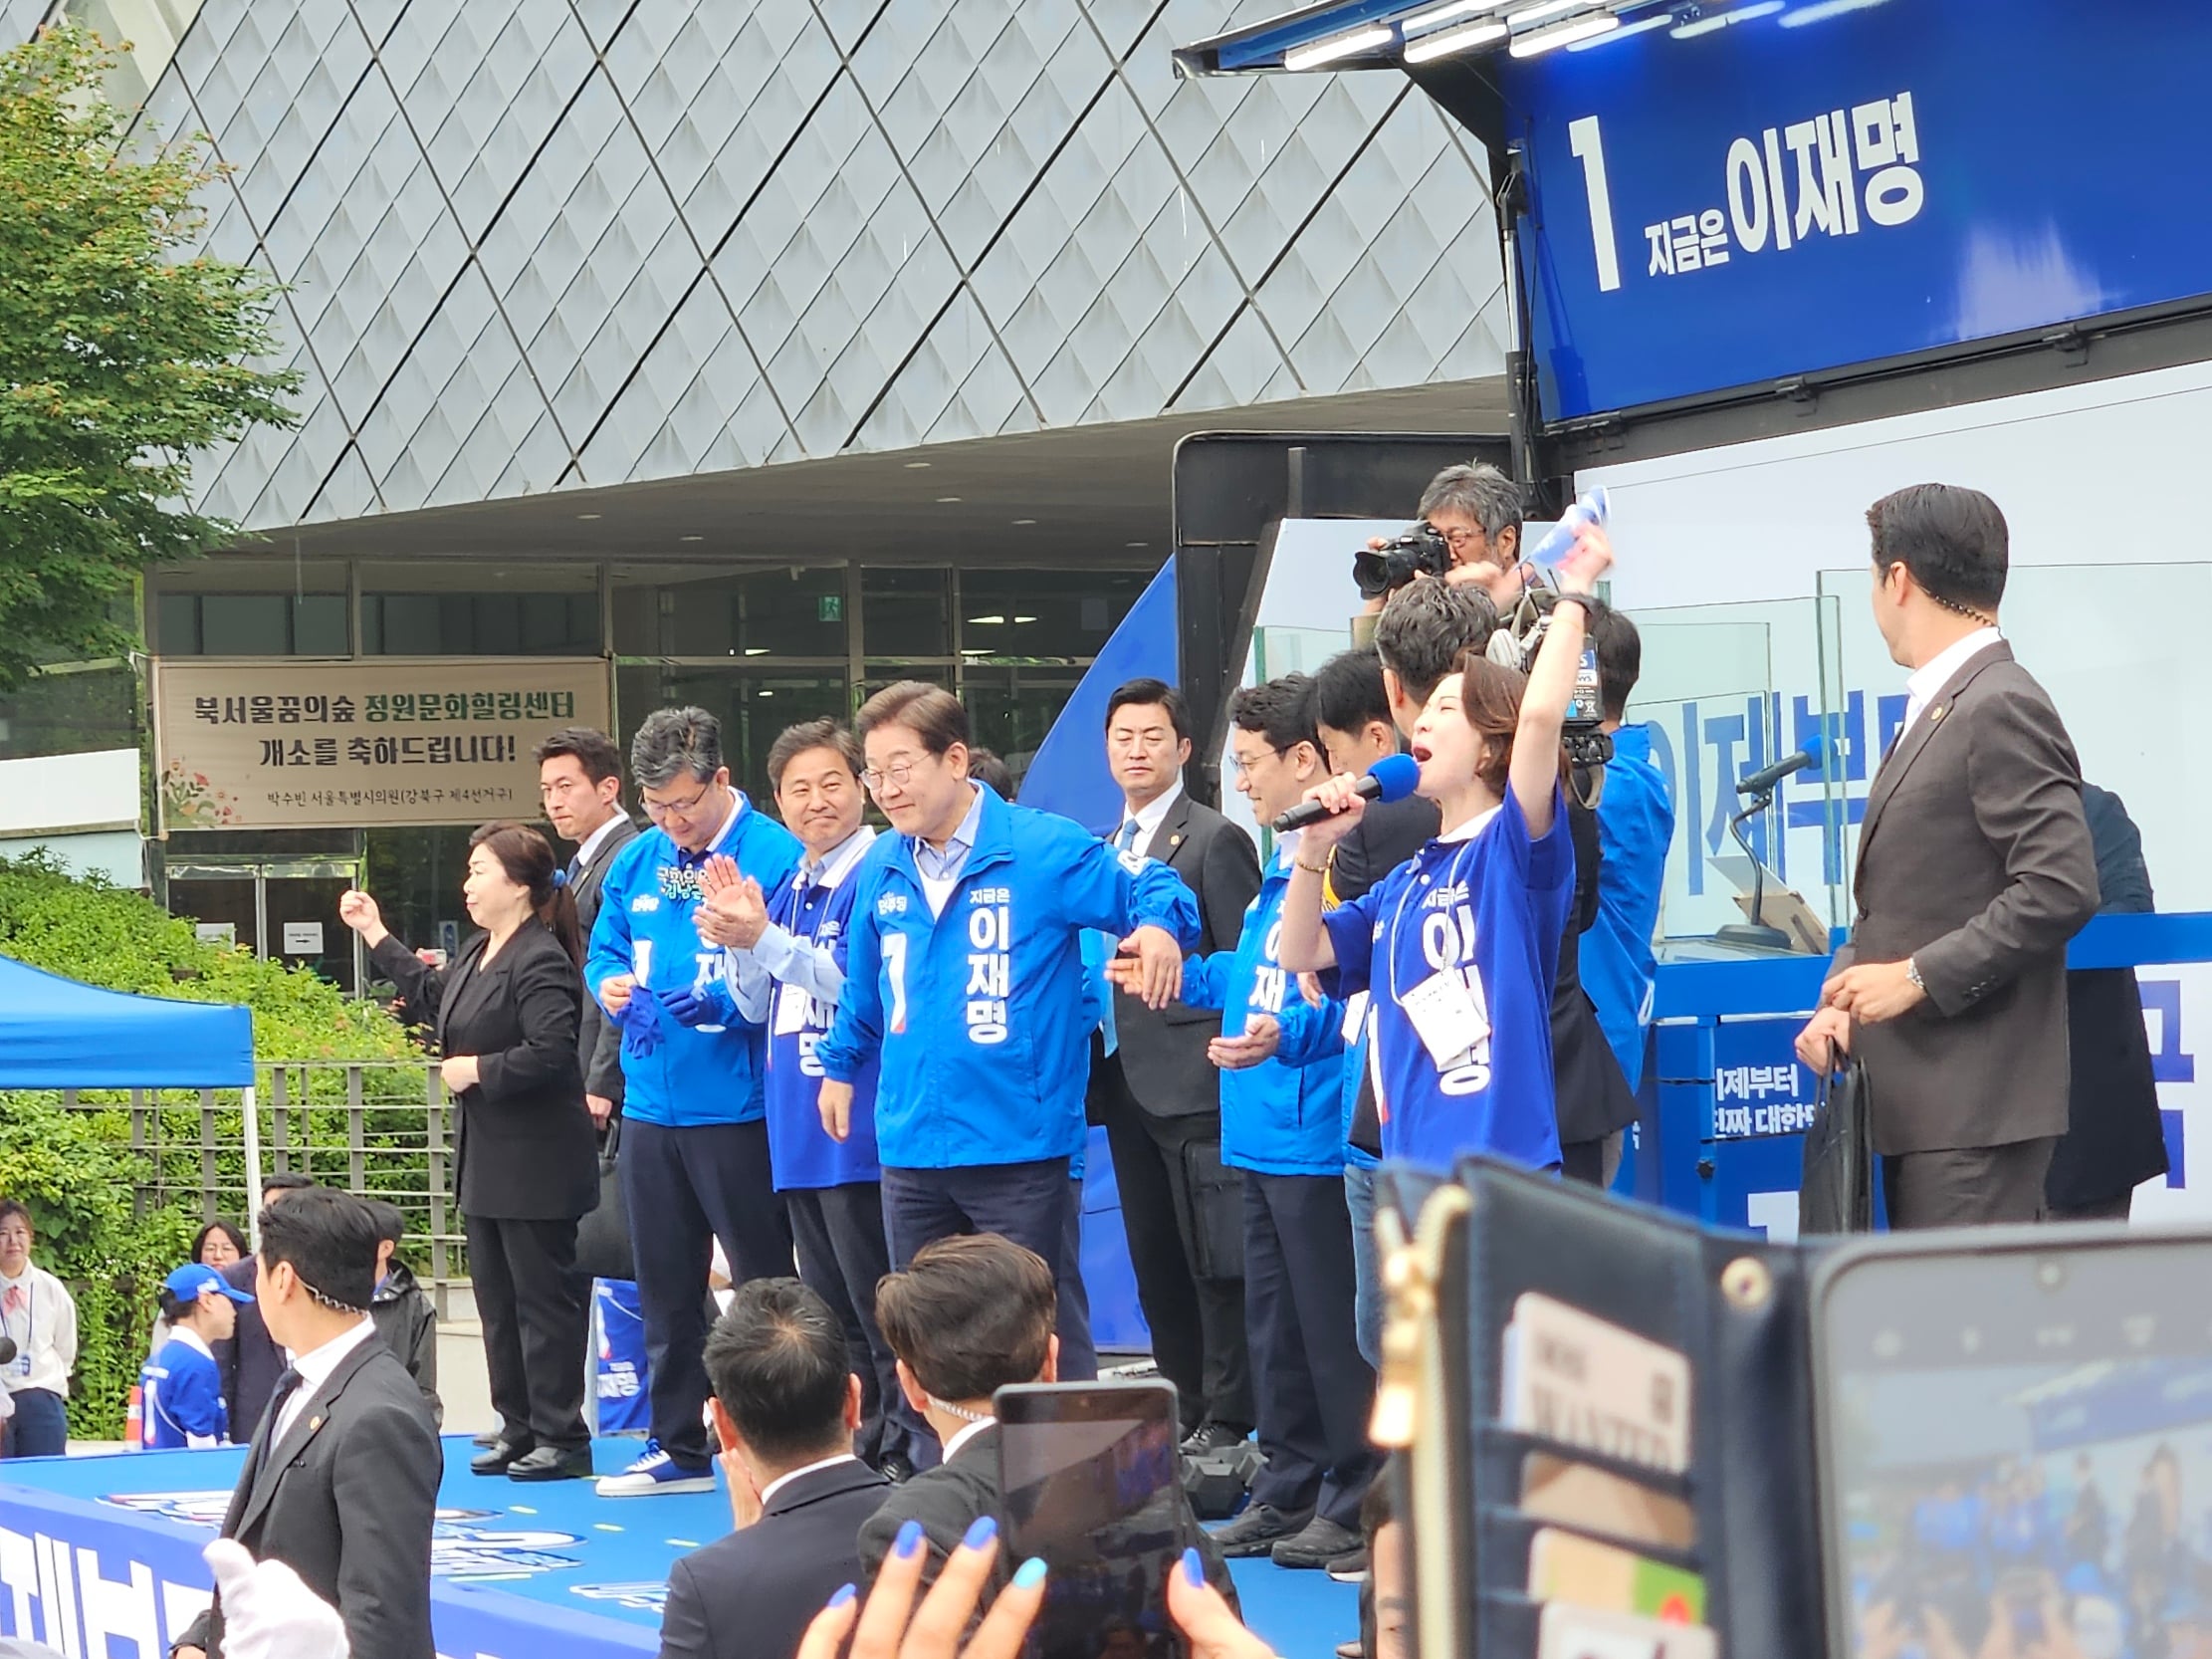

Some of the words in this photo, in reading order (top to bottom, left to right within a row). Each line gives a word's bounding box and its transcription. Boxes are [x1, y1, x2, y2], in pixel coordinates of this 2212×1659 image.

[1568, 115, 1621, 292] 1
[1645, 209, 1729, 277] 지금은
[1725, 92, 1924, 252] 이재명
[194, 695, 355, 724] 북서울꿈의숲
[364, 691, 575, 722] 정원문화힐링센터
[259, 737, 338, 767] 개소를
[347, 735, 516, 765] 축하드립니다!
[1646, 689, 1910, 896] 이제부
[969, 887, 1010, 904] 지금은
[882, 932, 907, 1034] 1
[967, 906, 1009, 1045] 이재명
[1422, 903, 1492, 1096] 이명
